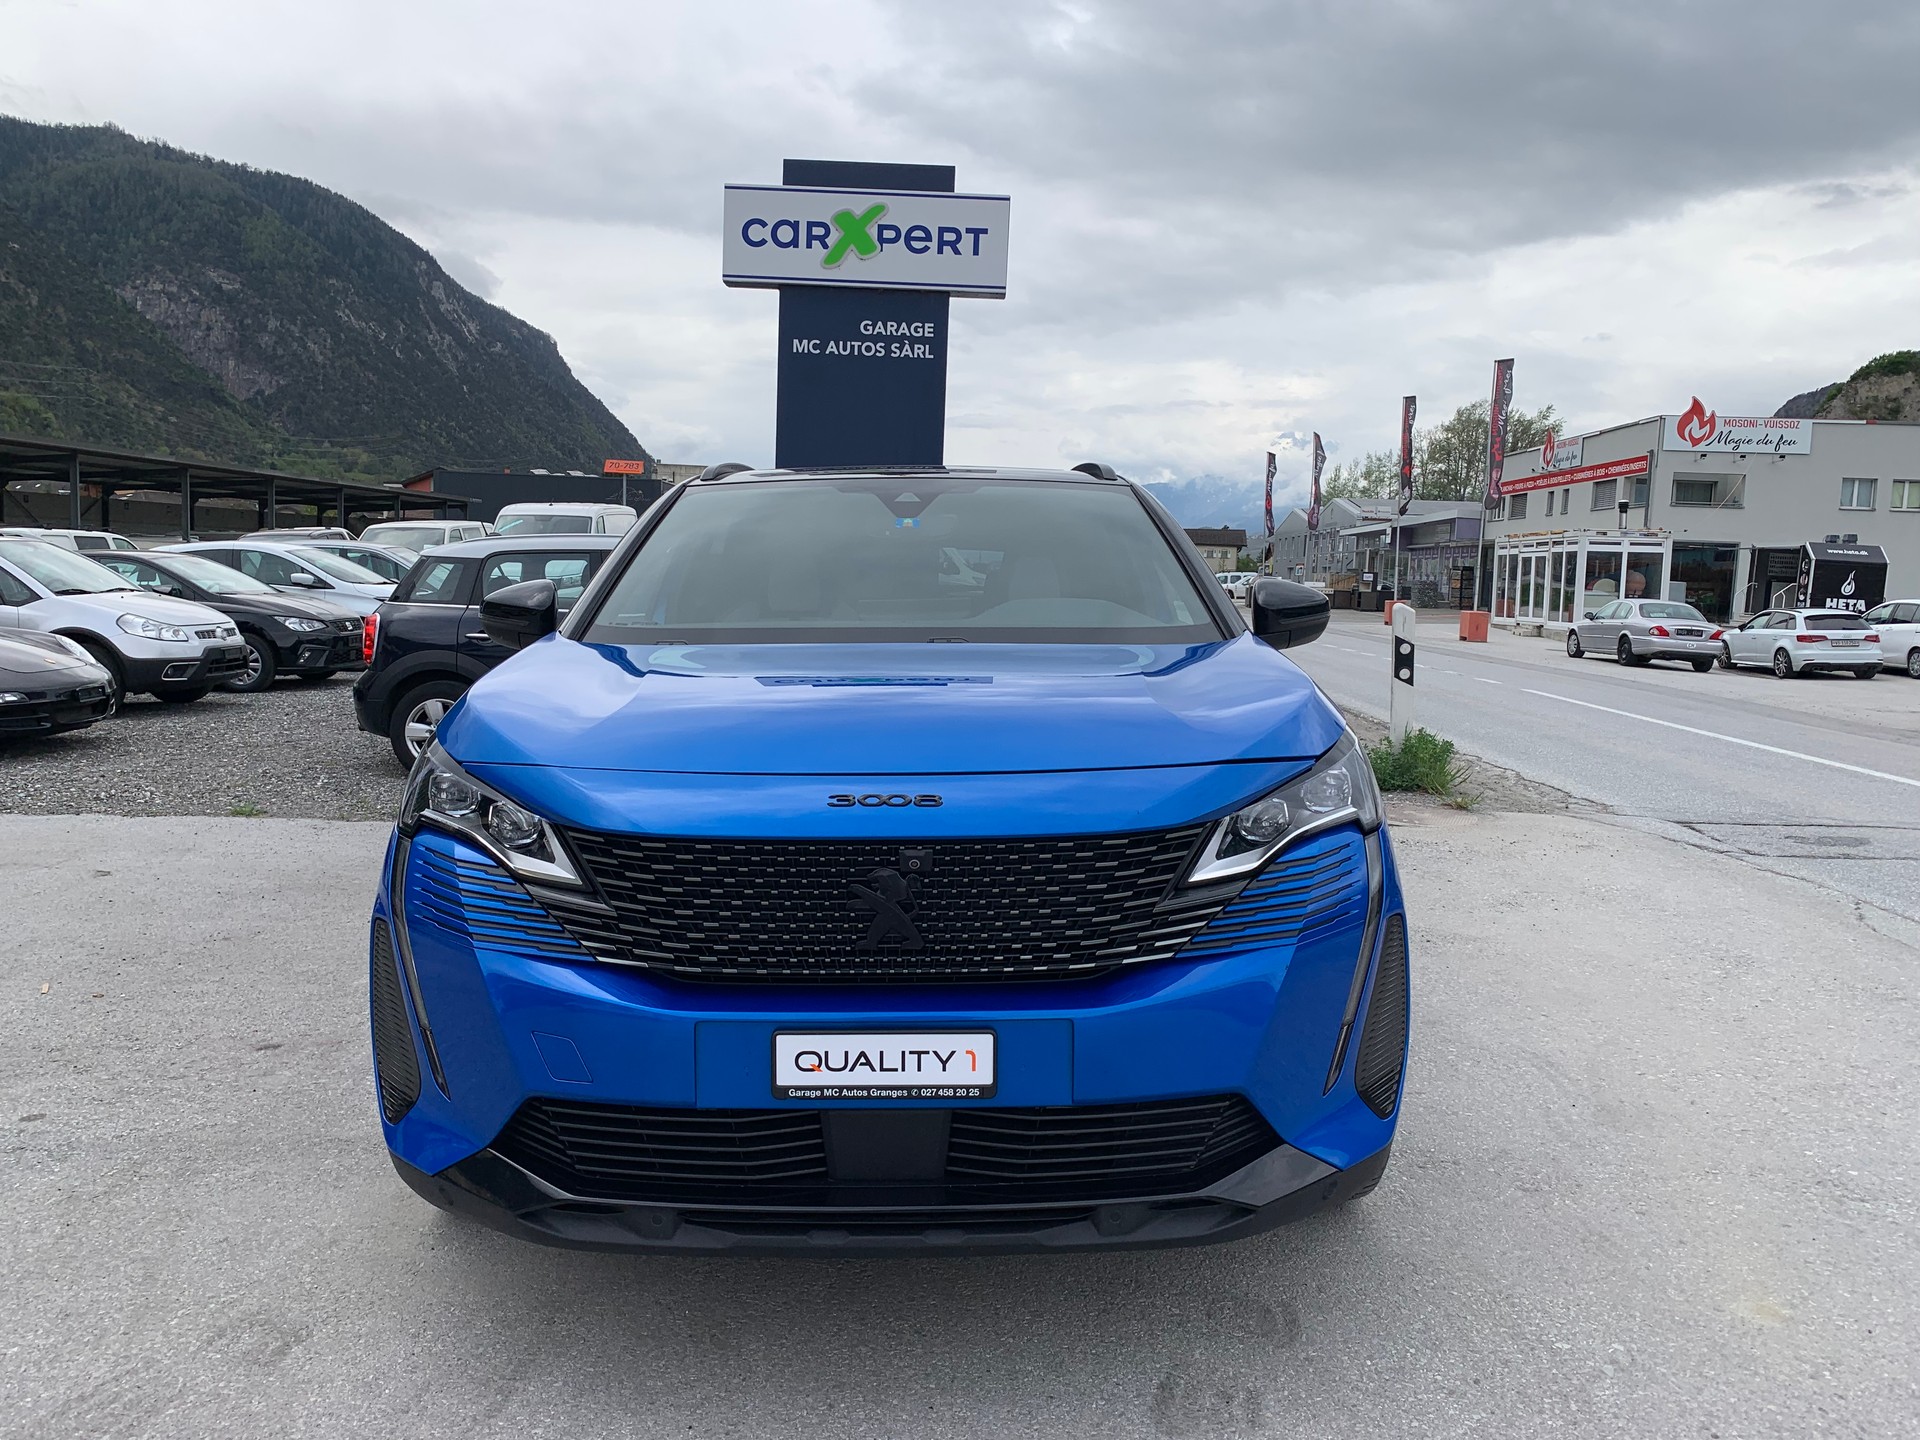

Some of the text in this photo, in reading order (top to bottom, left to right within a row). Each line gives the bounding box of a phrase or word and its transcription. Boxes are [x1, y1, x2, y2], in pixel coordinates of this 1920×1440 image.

[860, 320, 934, 337] GARAGE
[792, 338, 934, 359] MC AUTOS SÀRL
[1723, 419, 1801, 430] MOSONI-VUISSOZ
[1705, 429, 1798, 452] Magie du feu
[608, 461, 640, 470] 70-783
[1825, 597, 1867, 612] HETA
[826, 793, 944, 808] 3008
[794, 1050, 957, 1073] QUALITY
[788, 1088, 980, 1098] Garage MC Autos Granges 027 458 20 25
